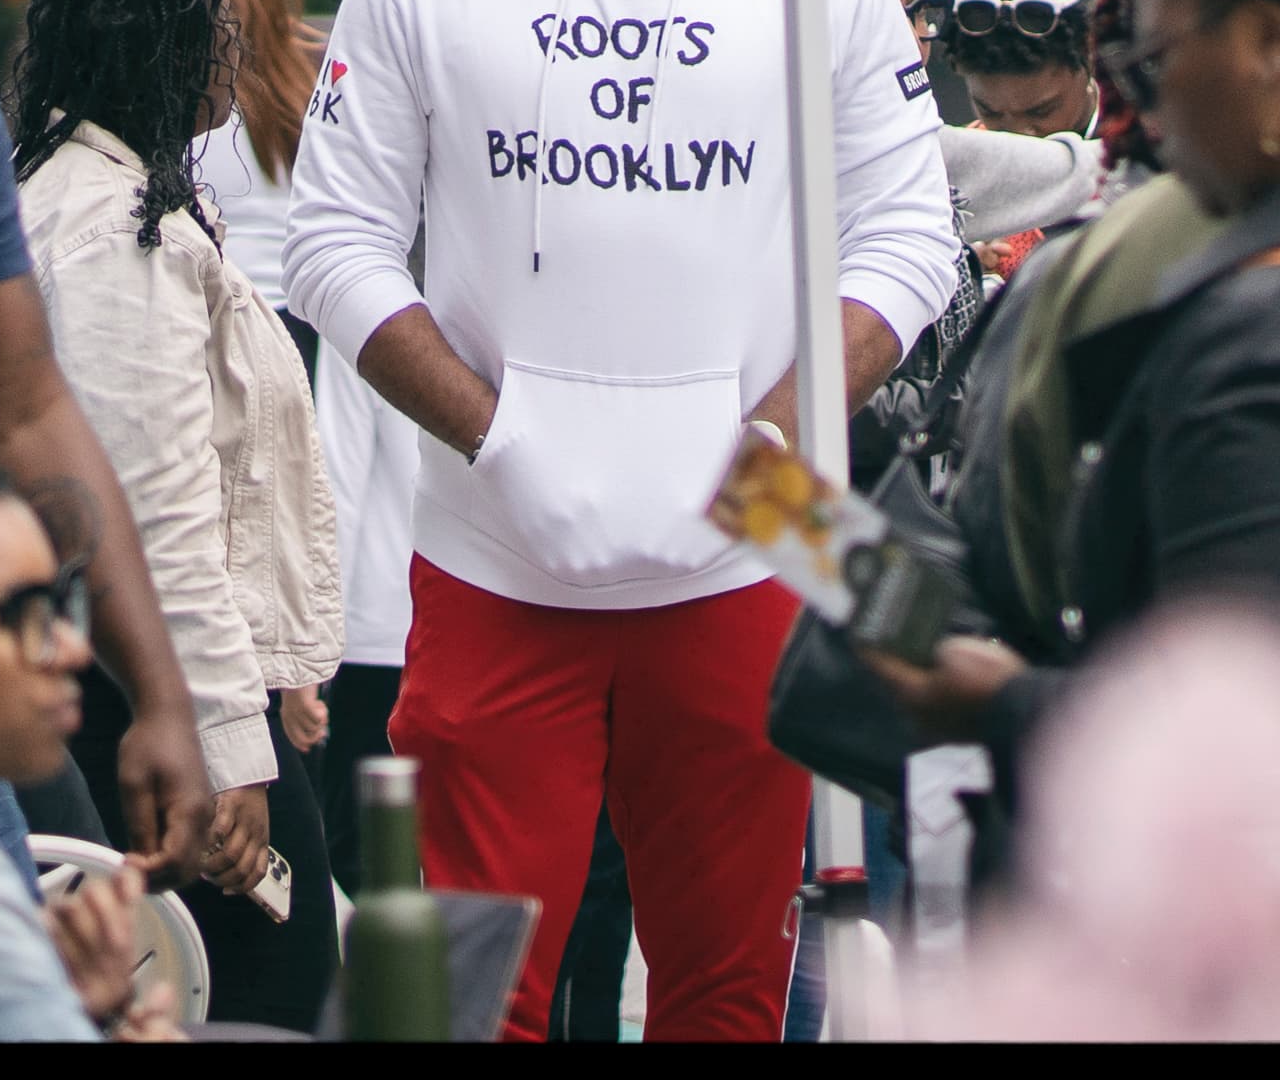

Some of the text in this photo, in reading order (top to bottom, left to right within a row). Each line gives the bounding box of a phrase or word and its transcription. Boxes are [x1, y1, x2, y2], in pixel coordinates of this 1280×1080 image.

[531, 13, 715, 65] ROOTS
[309, 89, 342, 125] BK
[590, 76, 655, 123] OF
[486, 129, 756, 192] BROOKLYN
